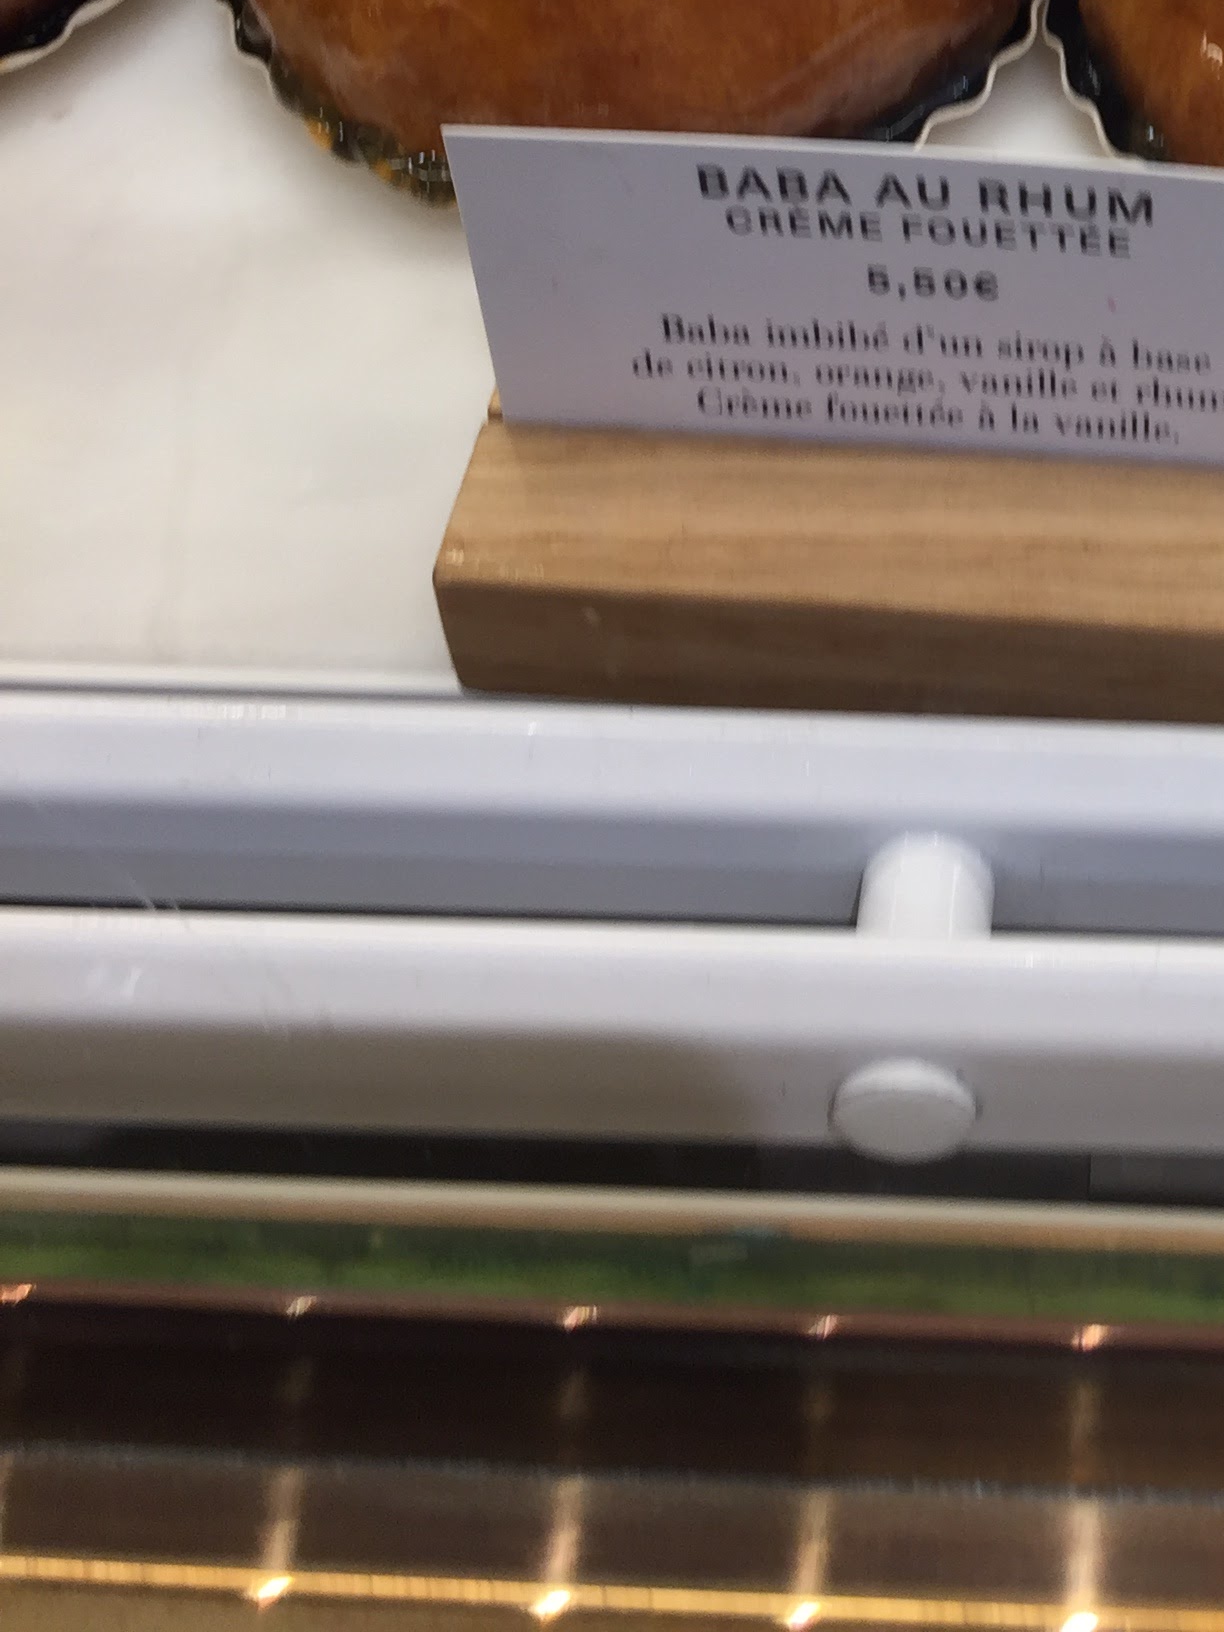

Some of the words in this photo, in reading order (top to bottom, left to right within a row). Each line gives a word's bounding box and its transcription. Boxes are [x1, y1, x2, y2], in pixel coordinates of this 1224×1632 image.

[697, 163, 852, 206] BABA
[875, 171, 950, 211] AU
[978, 177, 1153, 228] RHUM
[867, 262, 999, 302] 5,50€
[661, 313, 750, 346] Baba
[765, 317, 889, 351] imbibé
[998, 329, 1085, 372] sirop
[1100, 334, 1117, 369] à
[1131, 336, 1212, 375] base
[632, 347, 674, 380] de
[687, 351, 801, 386] citron,
[960, 366, 1078, 400] vanille
[1090, 377, 1119, 405] et
[697, 385, 812, 420] Crème
[978, 399, 996, 432] à
[1010, 401, 1040, 434] la
